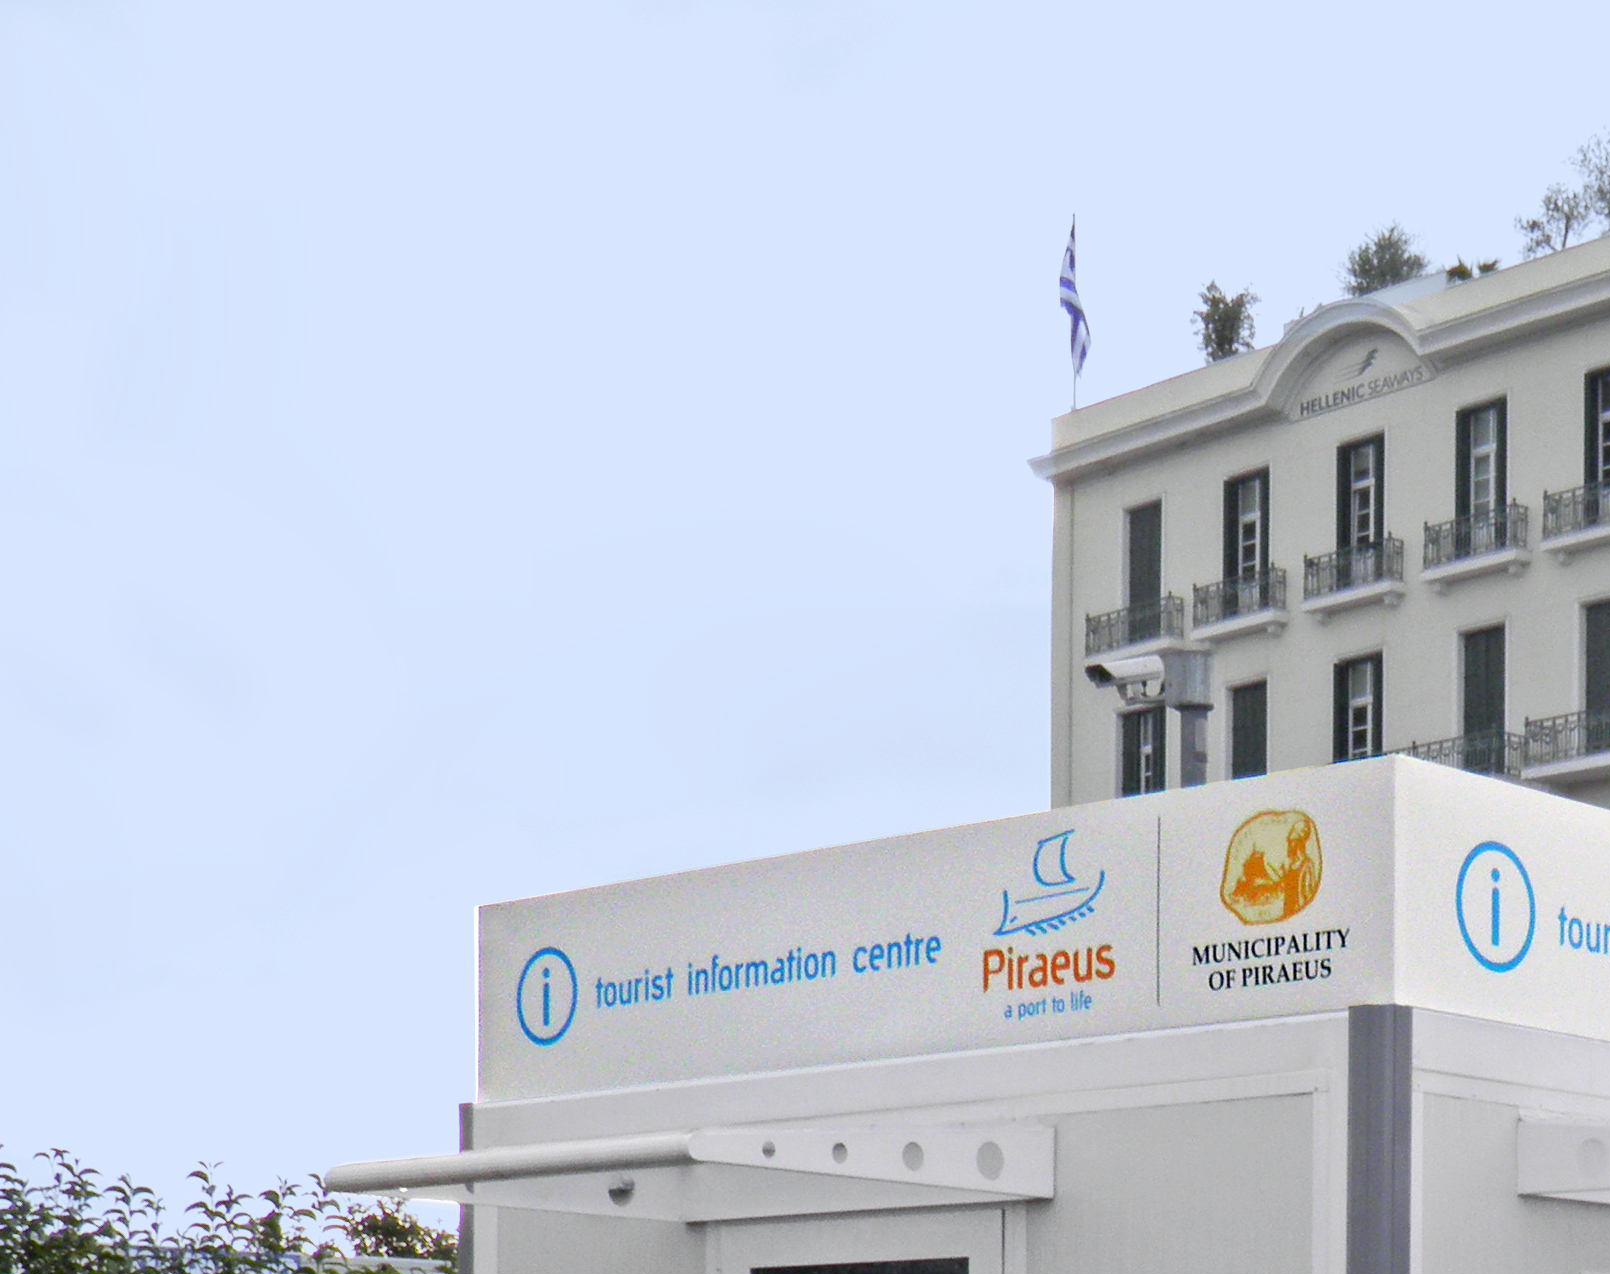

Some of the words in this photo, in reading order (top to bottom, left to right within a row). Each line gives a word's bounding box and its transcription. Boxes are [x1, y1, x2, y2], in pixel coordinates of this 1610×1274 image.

[1300, 384, 1366, 416] HELLENIC
[1367, 366, 1424, 396] SEAWAYS
[982, 944, 1117, 994] Piraeus
[1191, 928, 1351, 968] MUNICIPALITY
[596, 967, 674, 1009] tourist
[687, 946, 836, 996] information
[852, 933, 942, 974] centre
[1208, 971, 1235, 992] OF
[1241, 957, 1332, 988] PIRAEUS
[1004, 1008, 1012, 1020] a
[1018, 1000, 1047, 1020] port
[1052, 1000, 1065, 1013] to
[1070, 990, 1093, 1011] life
